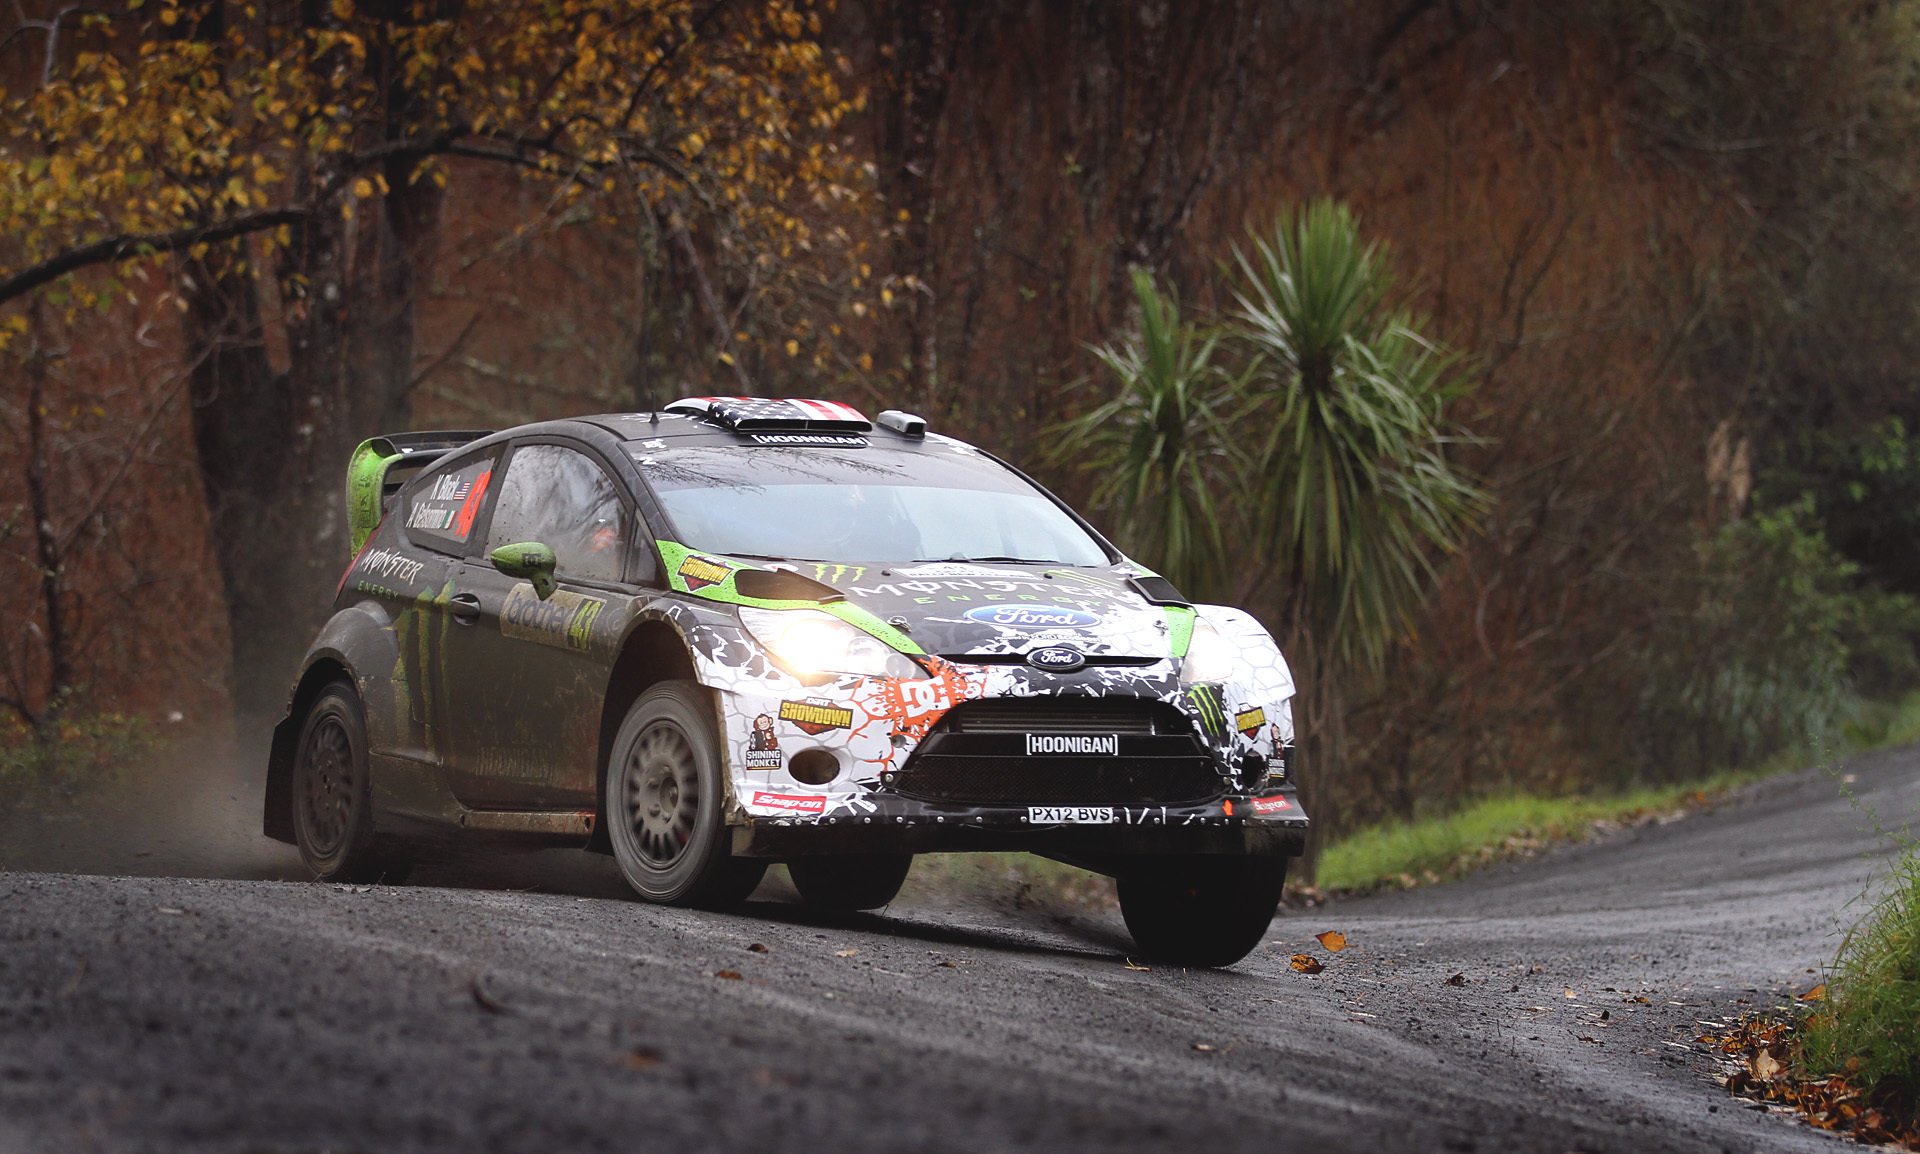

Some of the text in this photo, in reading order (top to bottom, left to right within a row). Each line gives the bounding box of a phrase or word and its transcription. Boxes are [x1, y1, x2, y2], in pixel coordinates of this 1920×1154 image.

[430, 474, 461, 501] K Block
[405, 502, 419, 528] A
[360, 547, 425, 586] MONSTER
[357, 579, 400, 600] ENERGY
[848, 578, 1114, 600] MONSTER
[569, 599, 602, 650] 43
[993, 606, 1079, 625] Ford
[1040, 649, 1073, 664] Ford
[900, 675, 951, 719] DC
[780, 702, 852, 728] SHOWDOWN
[746, 749, 781, 760] SHINING
[746, 758, 782, 768] MONKEY
[754, 794, 823, 811] Snap-on
[1032, 808, 1111, 821] PX12 BVS
